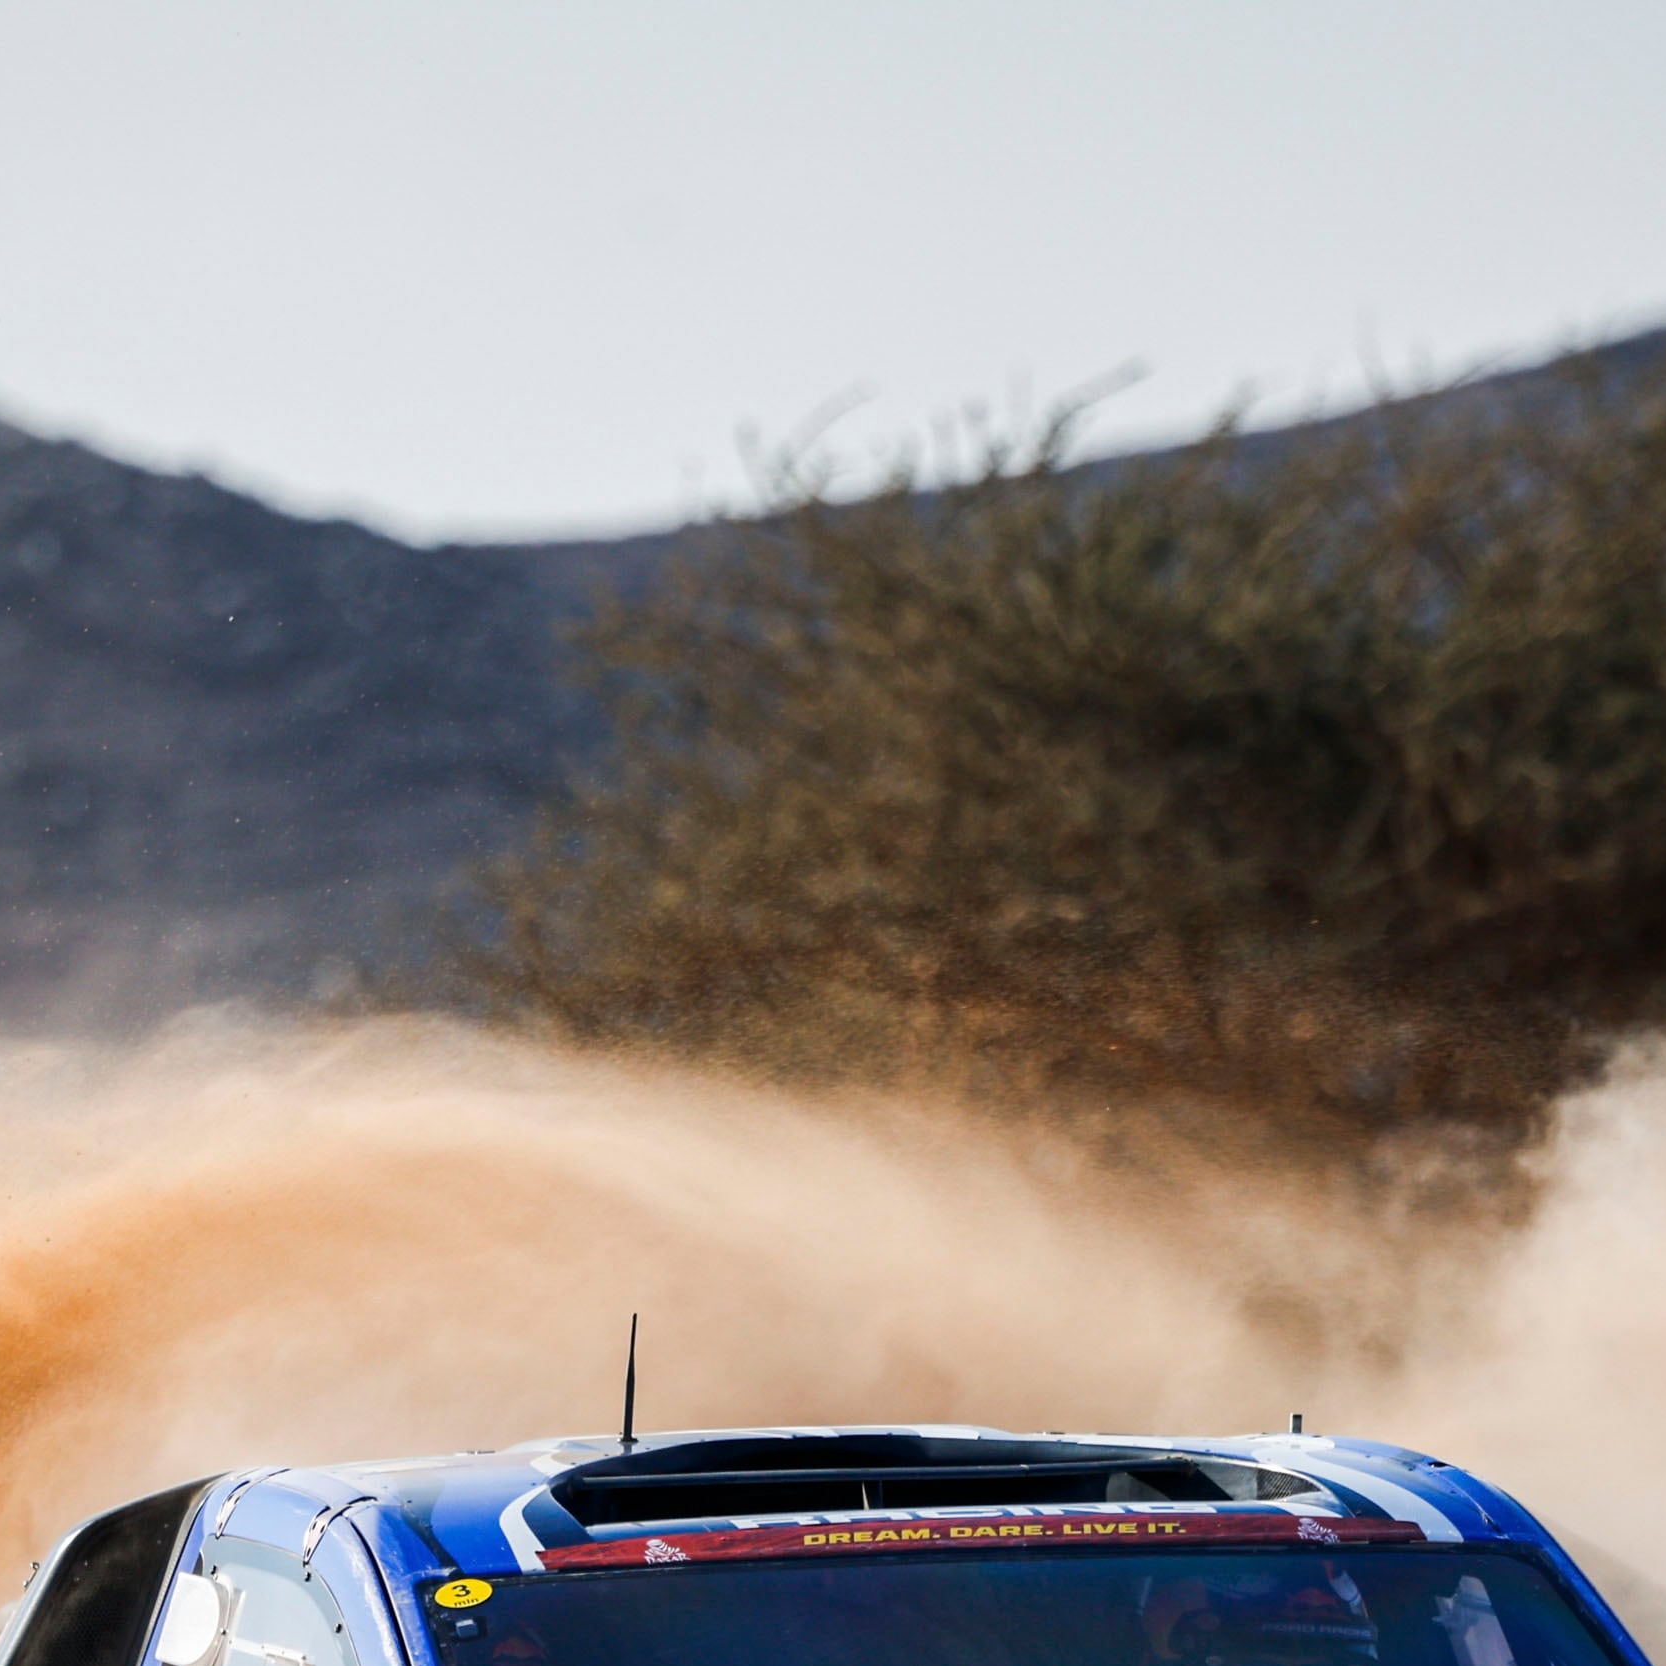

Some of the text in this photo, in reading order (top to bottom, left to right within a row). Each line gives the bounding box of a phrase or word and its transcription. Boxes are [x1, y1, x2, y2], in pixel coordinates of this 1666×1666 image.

[803, 1520, 1188, 1547] DREAM. DARE. LIVE IT.
[452, 1584, 471, 1598] 3
[453, 1597, 479, 1608] min
